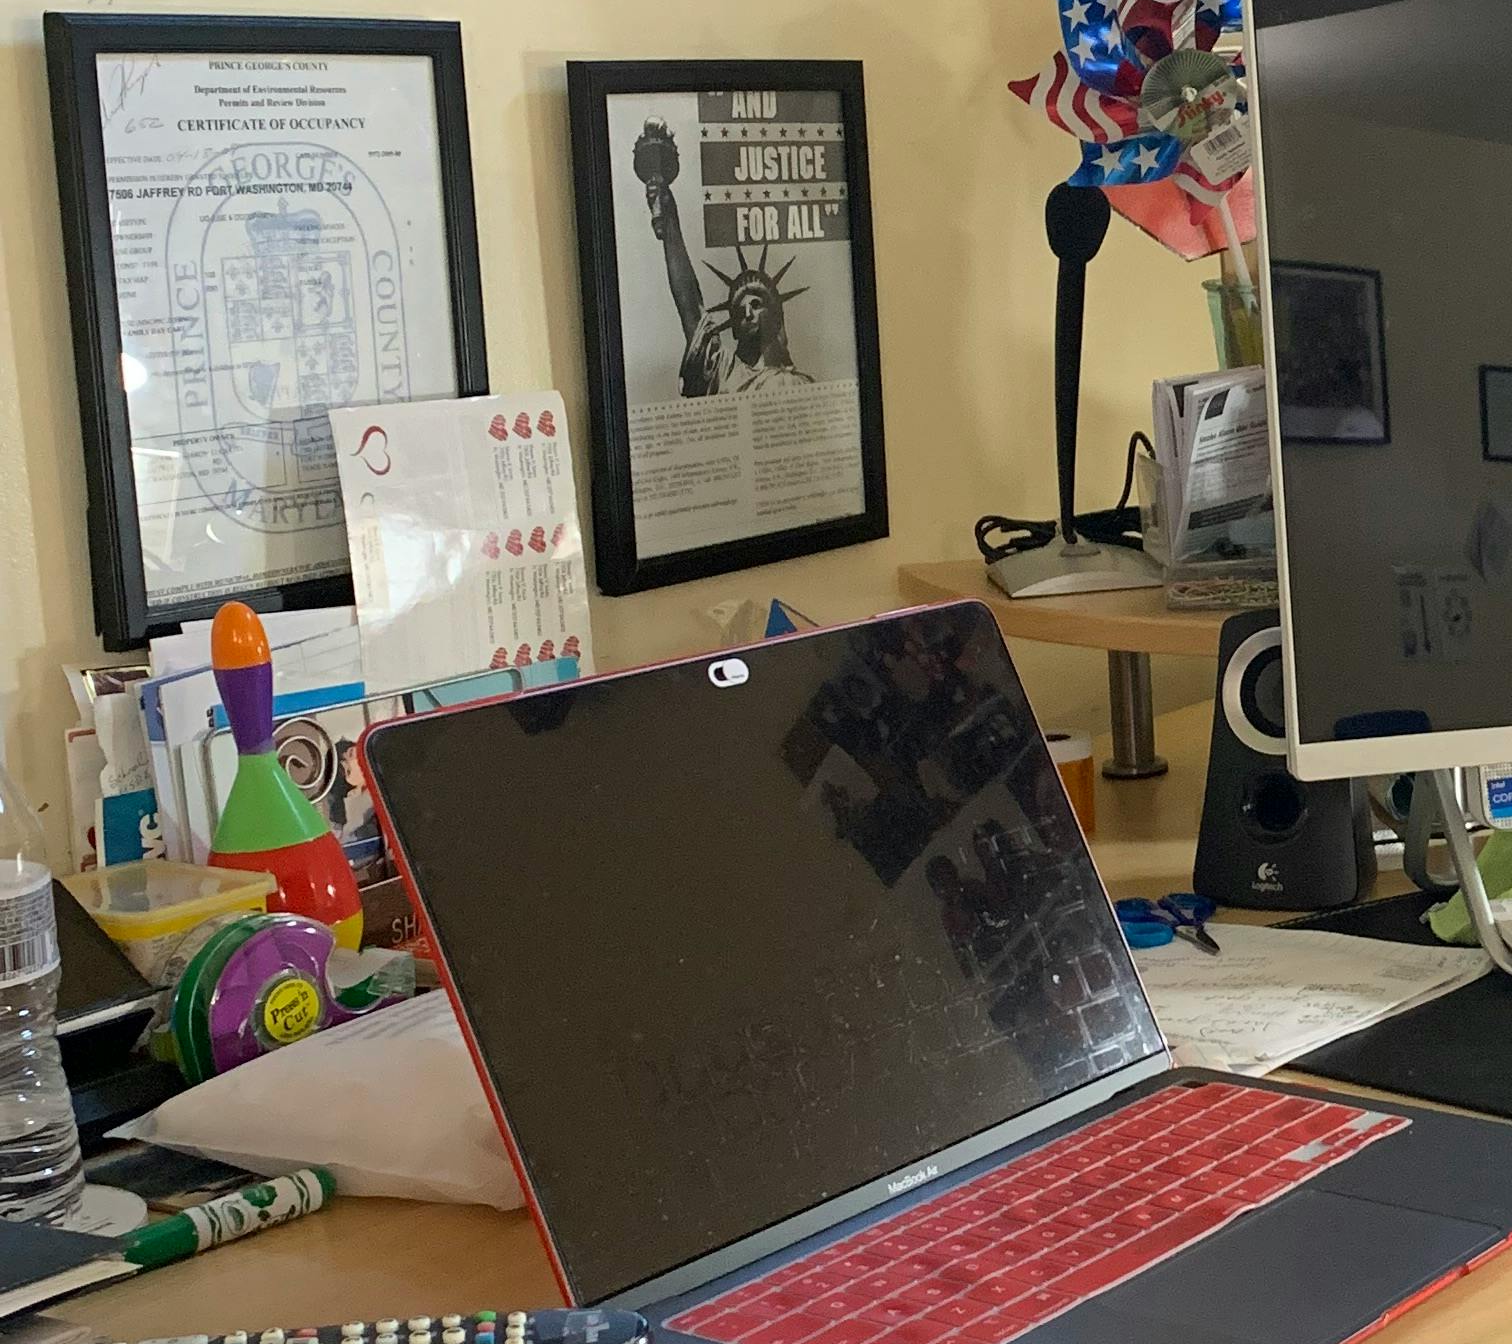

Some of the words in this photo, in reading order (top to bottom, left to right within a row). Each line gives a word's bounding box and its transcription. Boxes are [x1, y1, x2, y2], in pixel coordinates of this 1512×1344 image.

[209, 60, 244, 71] PRINCE
[293, 61, 329, 71] COUNTY
[193, 84, 242, 95] Department
[242, 85, 251, 94] of
[252, 85, 308, 94] Environmental
[309, 85, 347, 94] Resources
[218, 99, 249, 108] Permits
[250, 99, 265, 107] and
[266, 99, 294, 107] Review
[731, 90, 777, 119] AND
[177, 118, 266, 132] CERTIFICATE
[268, 118, 287, 131] OF
[289, 117, 366, 131] OCCUPANCY
[207, 151, 356, 196] GEORGE'S
[734, 145, 827, 182] JUSTICE
[109, 189, 134, 201] 7506
[136, 187, 185, 199] JAFFREY
[187, 186, 202, 197] RD
[205, 186, 232, 196] FORT
[235, 183, 305, 195] WASHINGTON,
[307, 183, 325, 192] MD
[736, 205, 780, 242] FOR
[173, 259, 208, 408] PRINCE
[371, 249, 405, 402] COUNTY
[1251, 881, 1284, 893] Logitech
